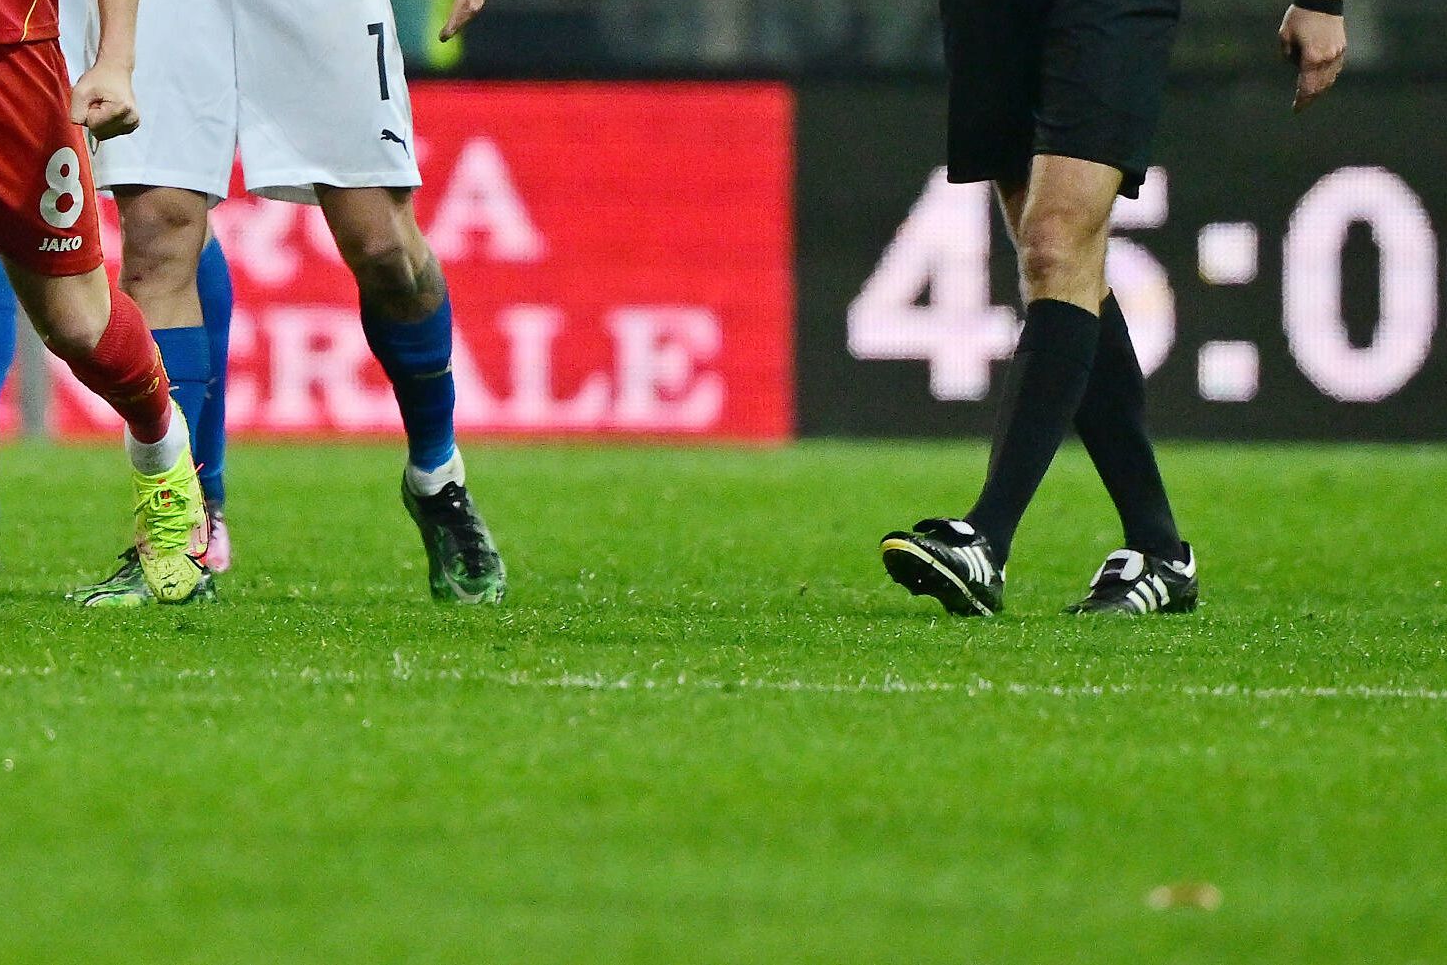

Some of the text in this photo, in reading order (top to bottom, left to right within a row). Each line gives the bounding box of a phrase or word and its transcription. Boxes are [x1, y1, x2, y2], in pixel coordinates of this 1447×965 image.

[367, 22, 390, 100] 7
[40, 146, 84, 228] 8
[38, 235, 83, 252] JAKO
